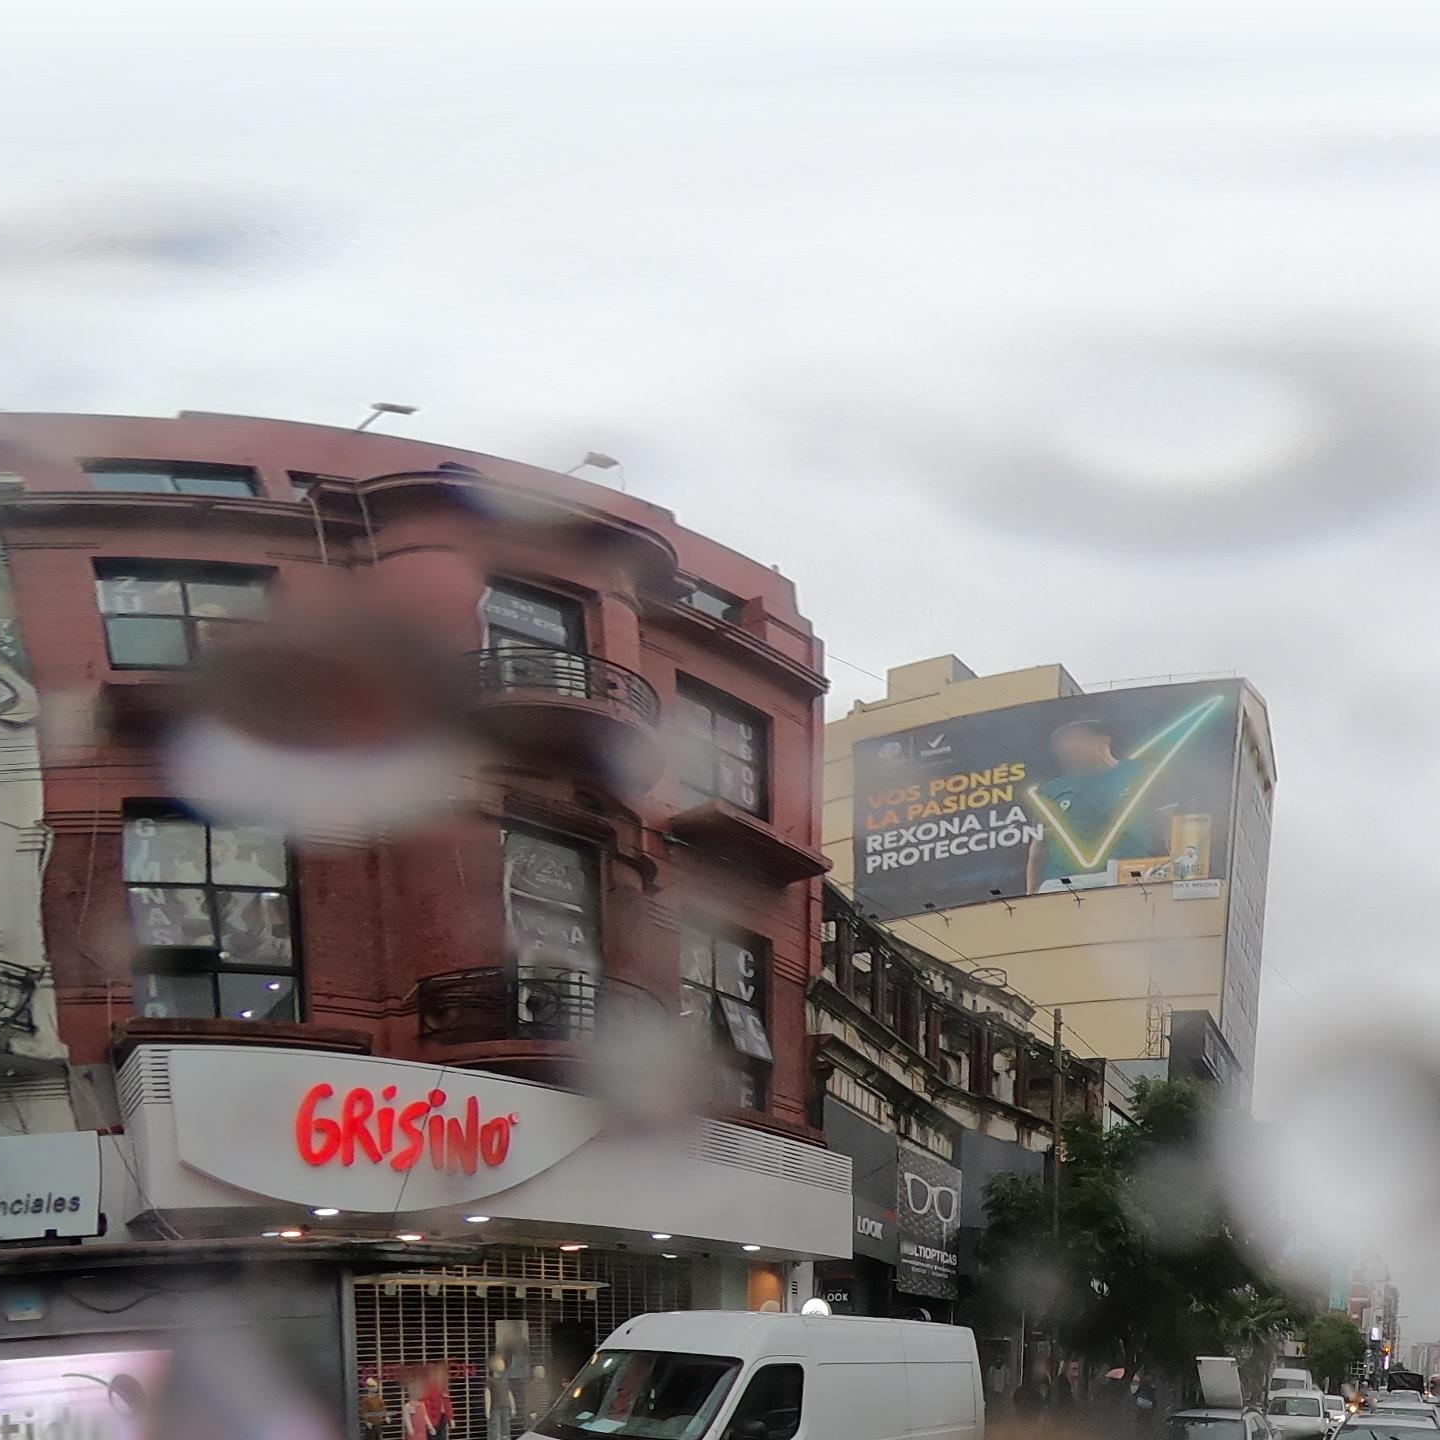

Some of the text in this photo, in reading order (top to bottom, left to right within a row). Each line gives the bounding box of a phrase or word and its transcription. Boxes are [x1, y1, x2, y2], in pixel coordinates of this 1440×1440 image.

[930, 763, 1026, 797] PONÉS
[866, 806, 1028, 853] REXONA LA
[867, 785, 1014, 831] LA PASIÓN
[866, 823, 1045, 874] PROTECCIÓN
[856, 1215, 884, 1241] LOOK
